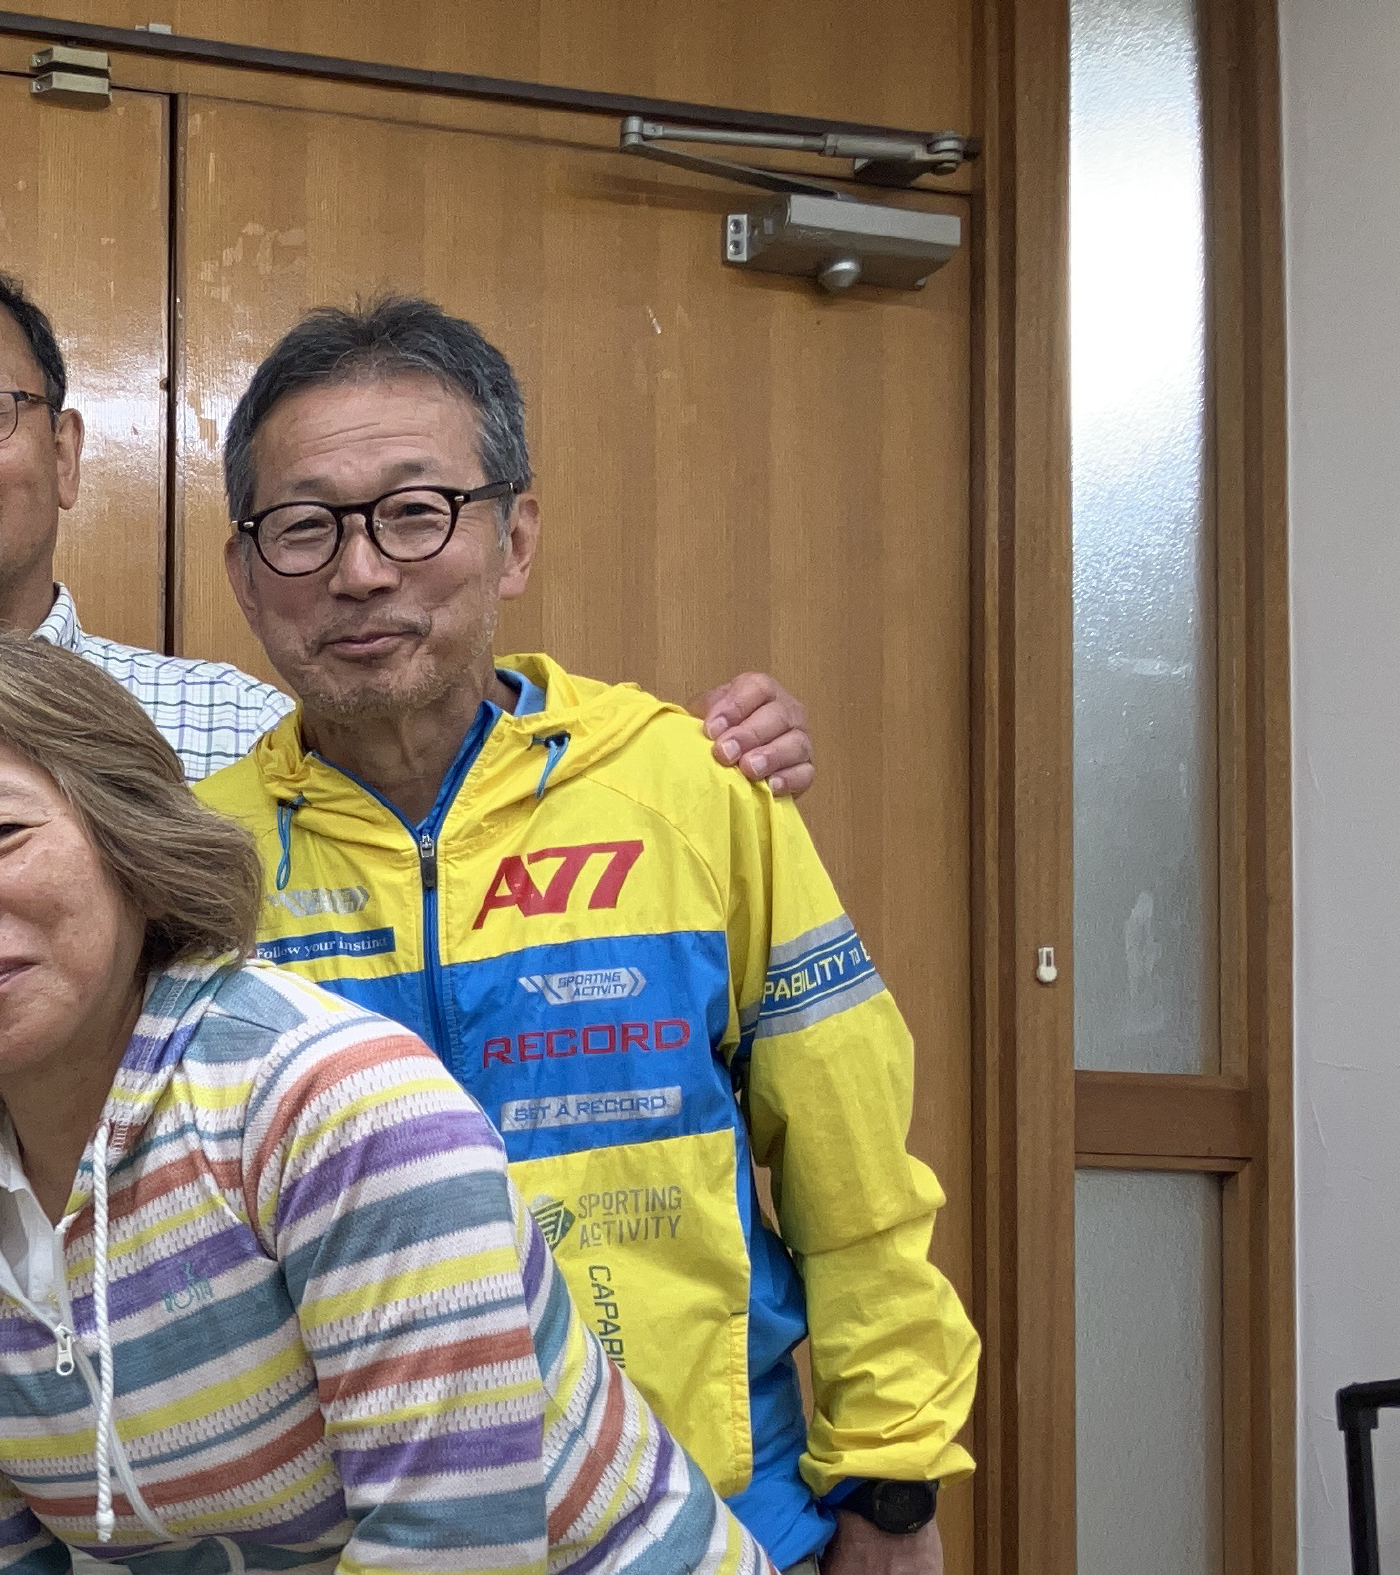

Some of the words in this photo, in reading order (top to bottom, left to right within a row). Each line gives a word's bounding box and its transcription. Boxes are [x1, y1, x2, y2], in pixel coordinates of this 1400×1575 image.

[471, 839, 645, 930] A77
[256, 945, 301, 959] Follow
[304, 940, 336, 957] your
[558, 971, 622, 989] SPORTING
[573, 983, 628, 999] ACTIVITY
[483, 1019, 690, 1069] RECORD
[557, 1104, 571, 1118] A
[577, 1096, 667, 1115] RECORD
[578, 1186, 682, 1219] SPORTING
[580, 1214, 682, 1250] ACTIVITY
